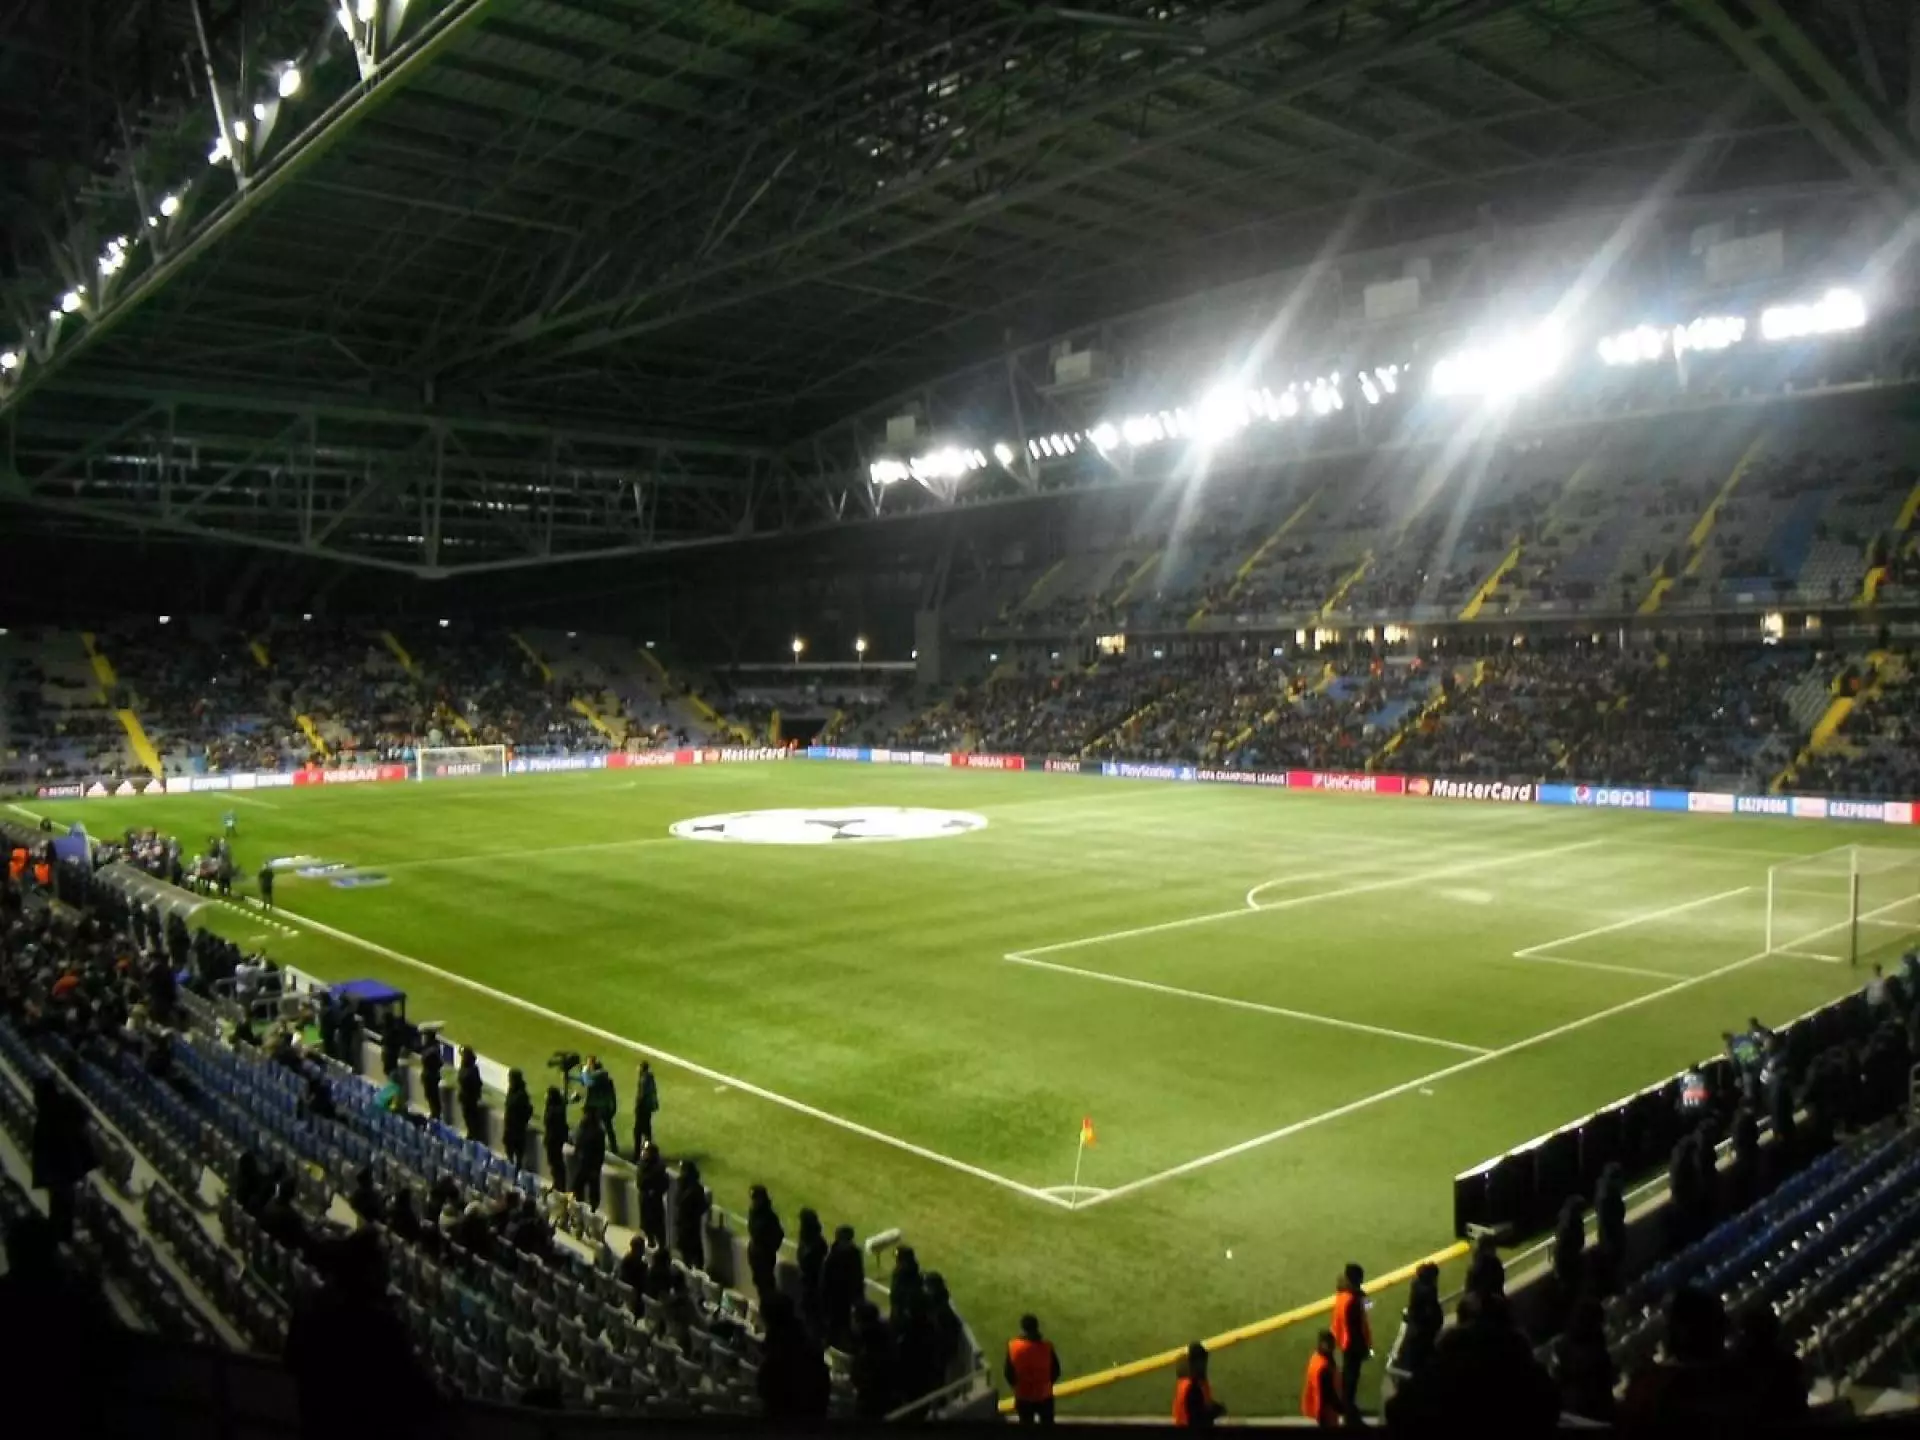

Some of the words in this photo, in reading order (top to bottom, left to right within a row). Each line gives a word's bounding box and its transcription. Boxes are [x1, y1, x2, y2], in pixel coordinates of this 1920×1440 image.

[1120, 763, 1176, 779] PlayStation
[1324, 774, 1377, 792] UniCredit
[1431, 778, 1532, 801] MasterCard
[1595, 789, 1652, 808] pepsi
